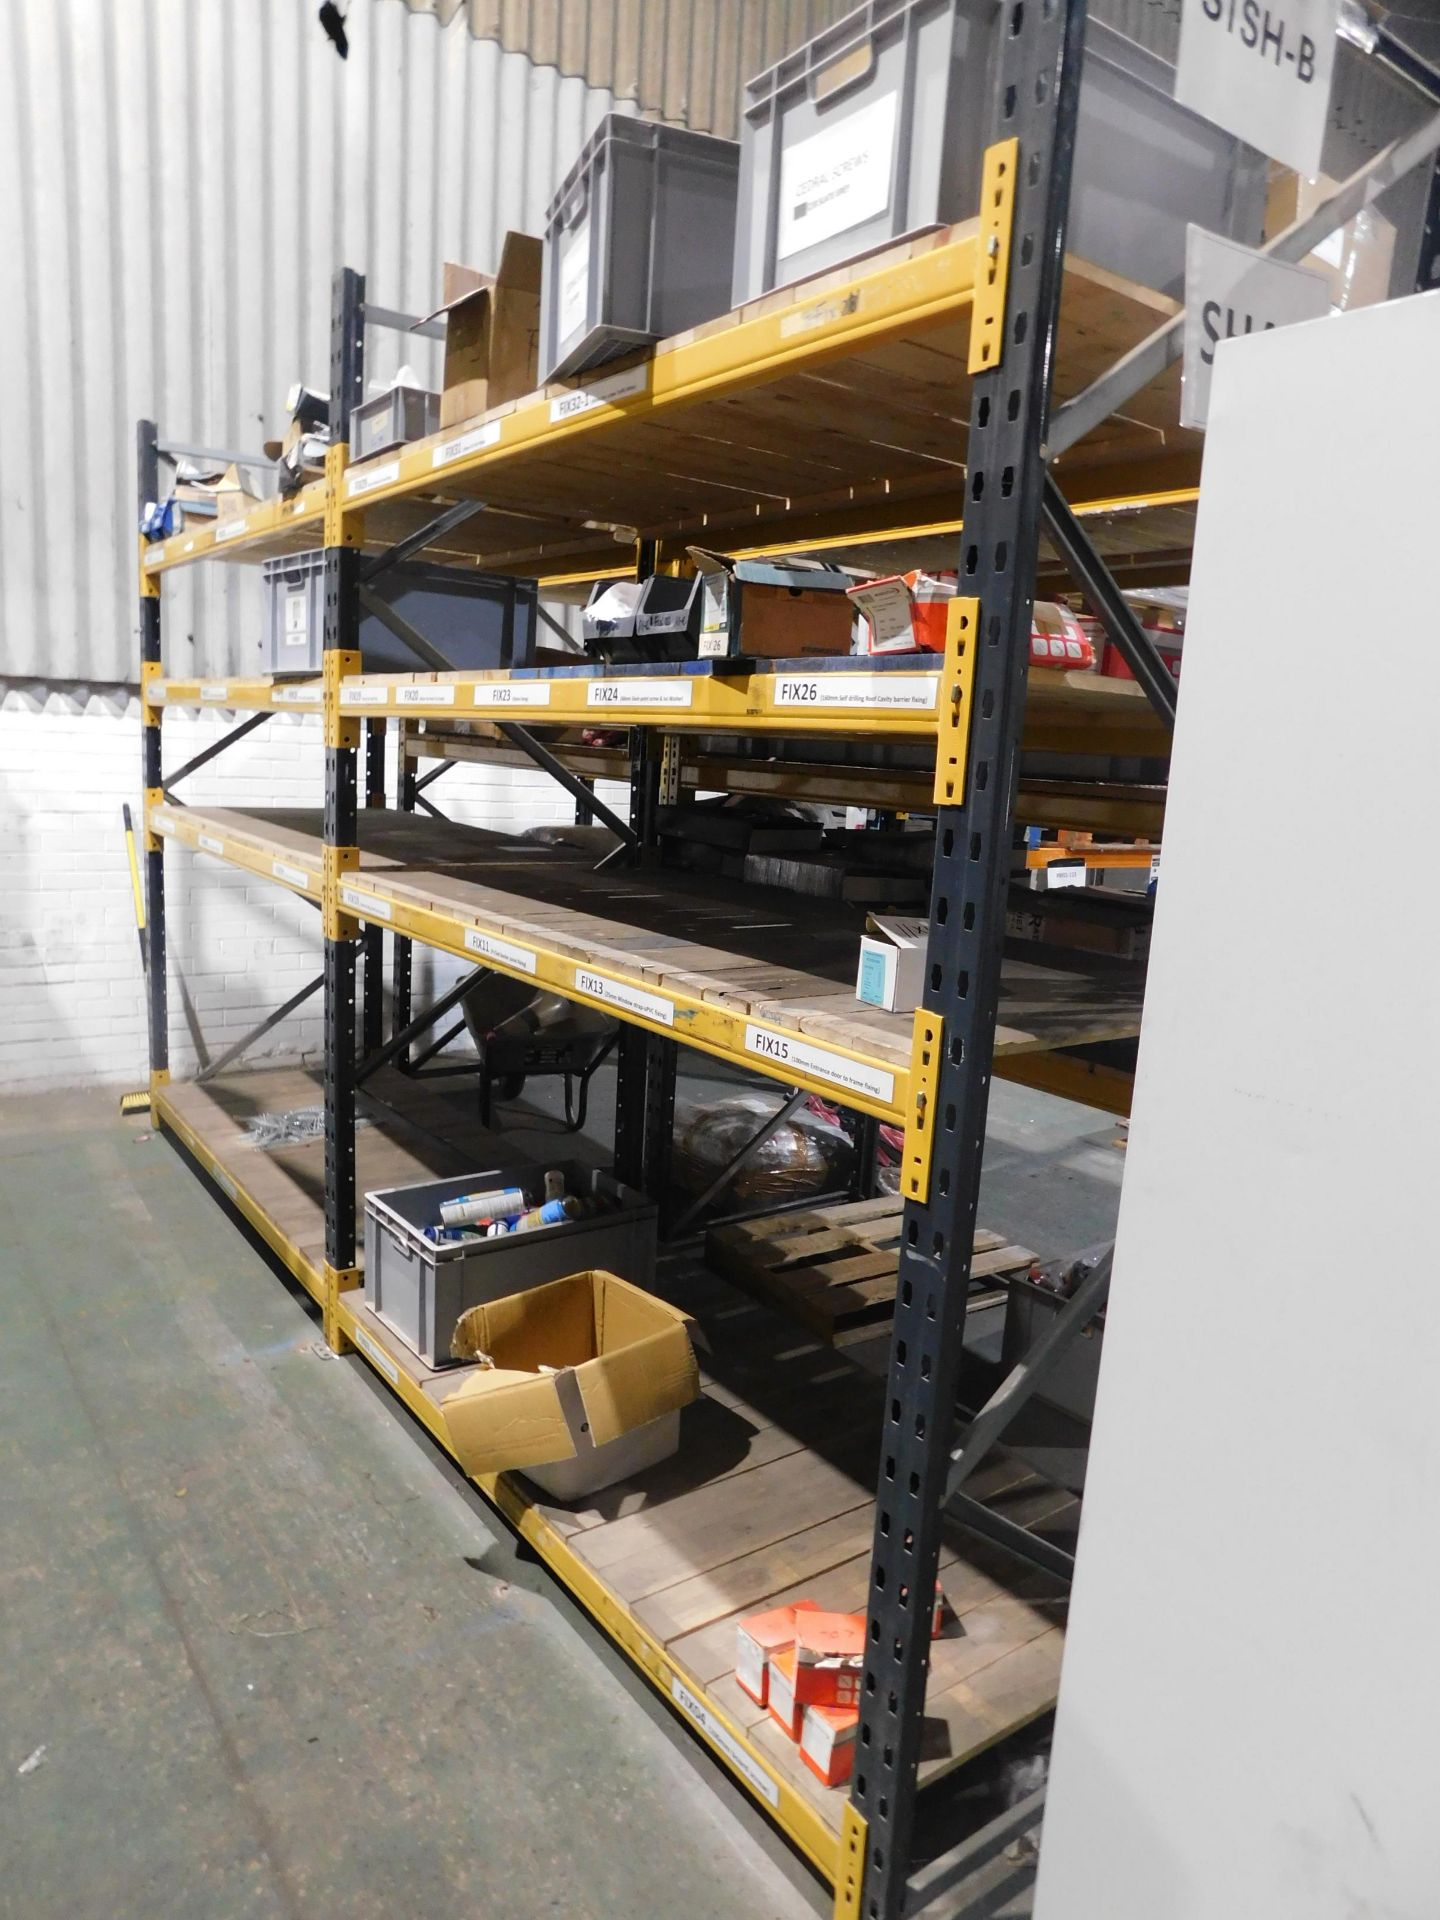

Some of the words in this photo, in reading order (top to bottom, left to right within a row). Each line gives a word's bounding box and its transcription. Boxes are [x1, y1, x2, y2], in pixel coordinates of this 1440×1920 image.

[492, 688, 511, 702] FIX23
[594, 687, 618, 702] FIX24
[781, 683, 817, 701] FIX26
[848, 694, 865, 703] drilling
[877, 695, 893, 704] Cavity
[472, 935, 490, 952] FIX11
[580, 975, 603, 994] FIX13
[756, 1033, 789, 1059] FIX15
[810, 1062, 831, 1076] Entrance
[831, 1069, 843, 1080] door
[849, 1076, 864, 1087] frame
[864, 1082, 881, 1095] fixing)
